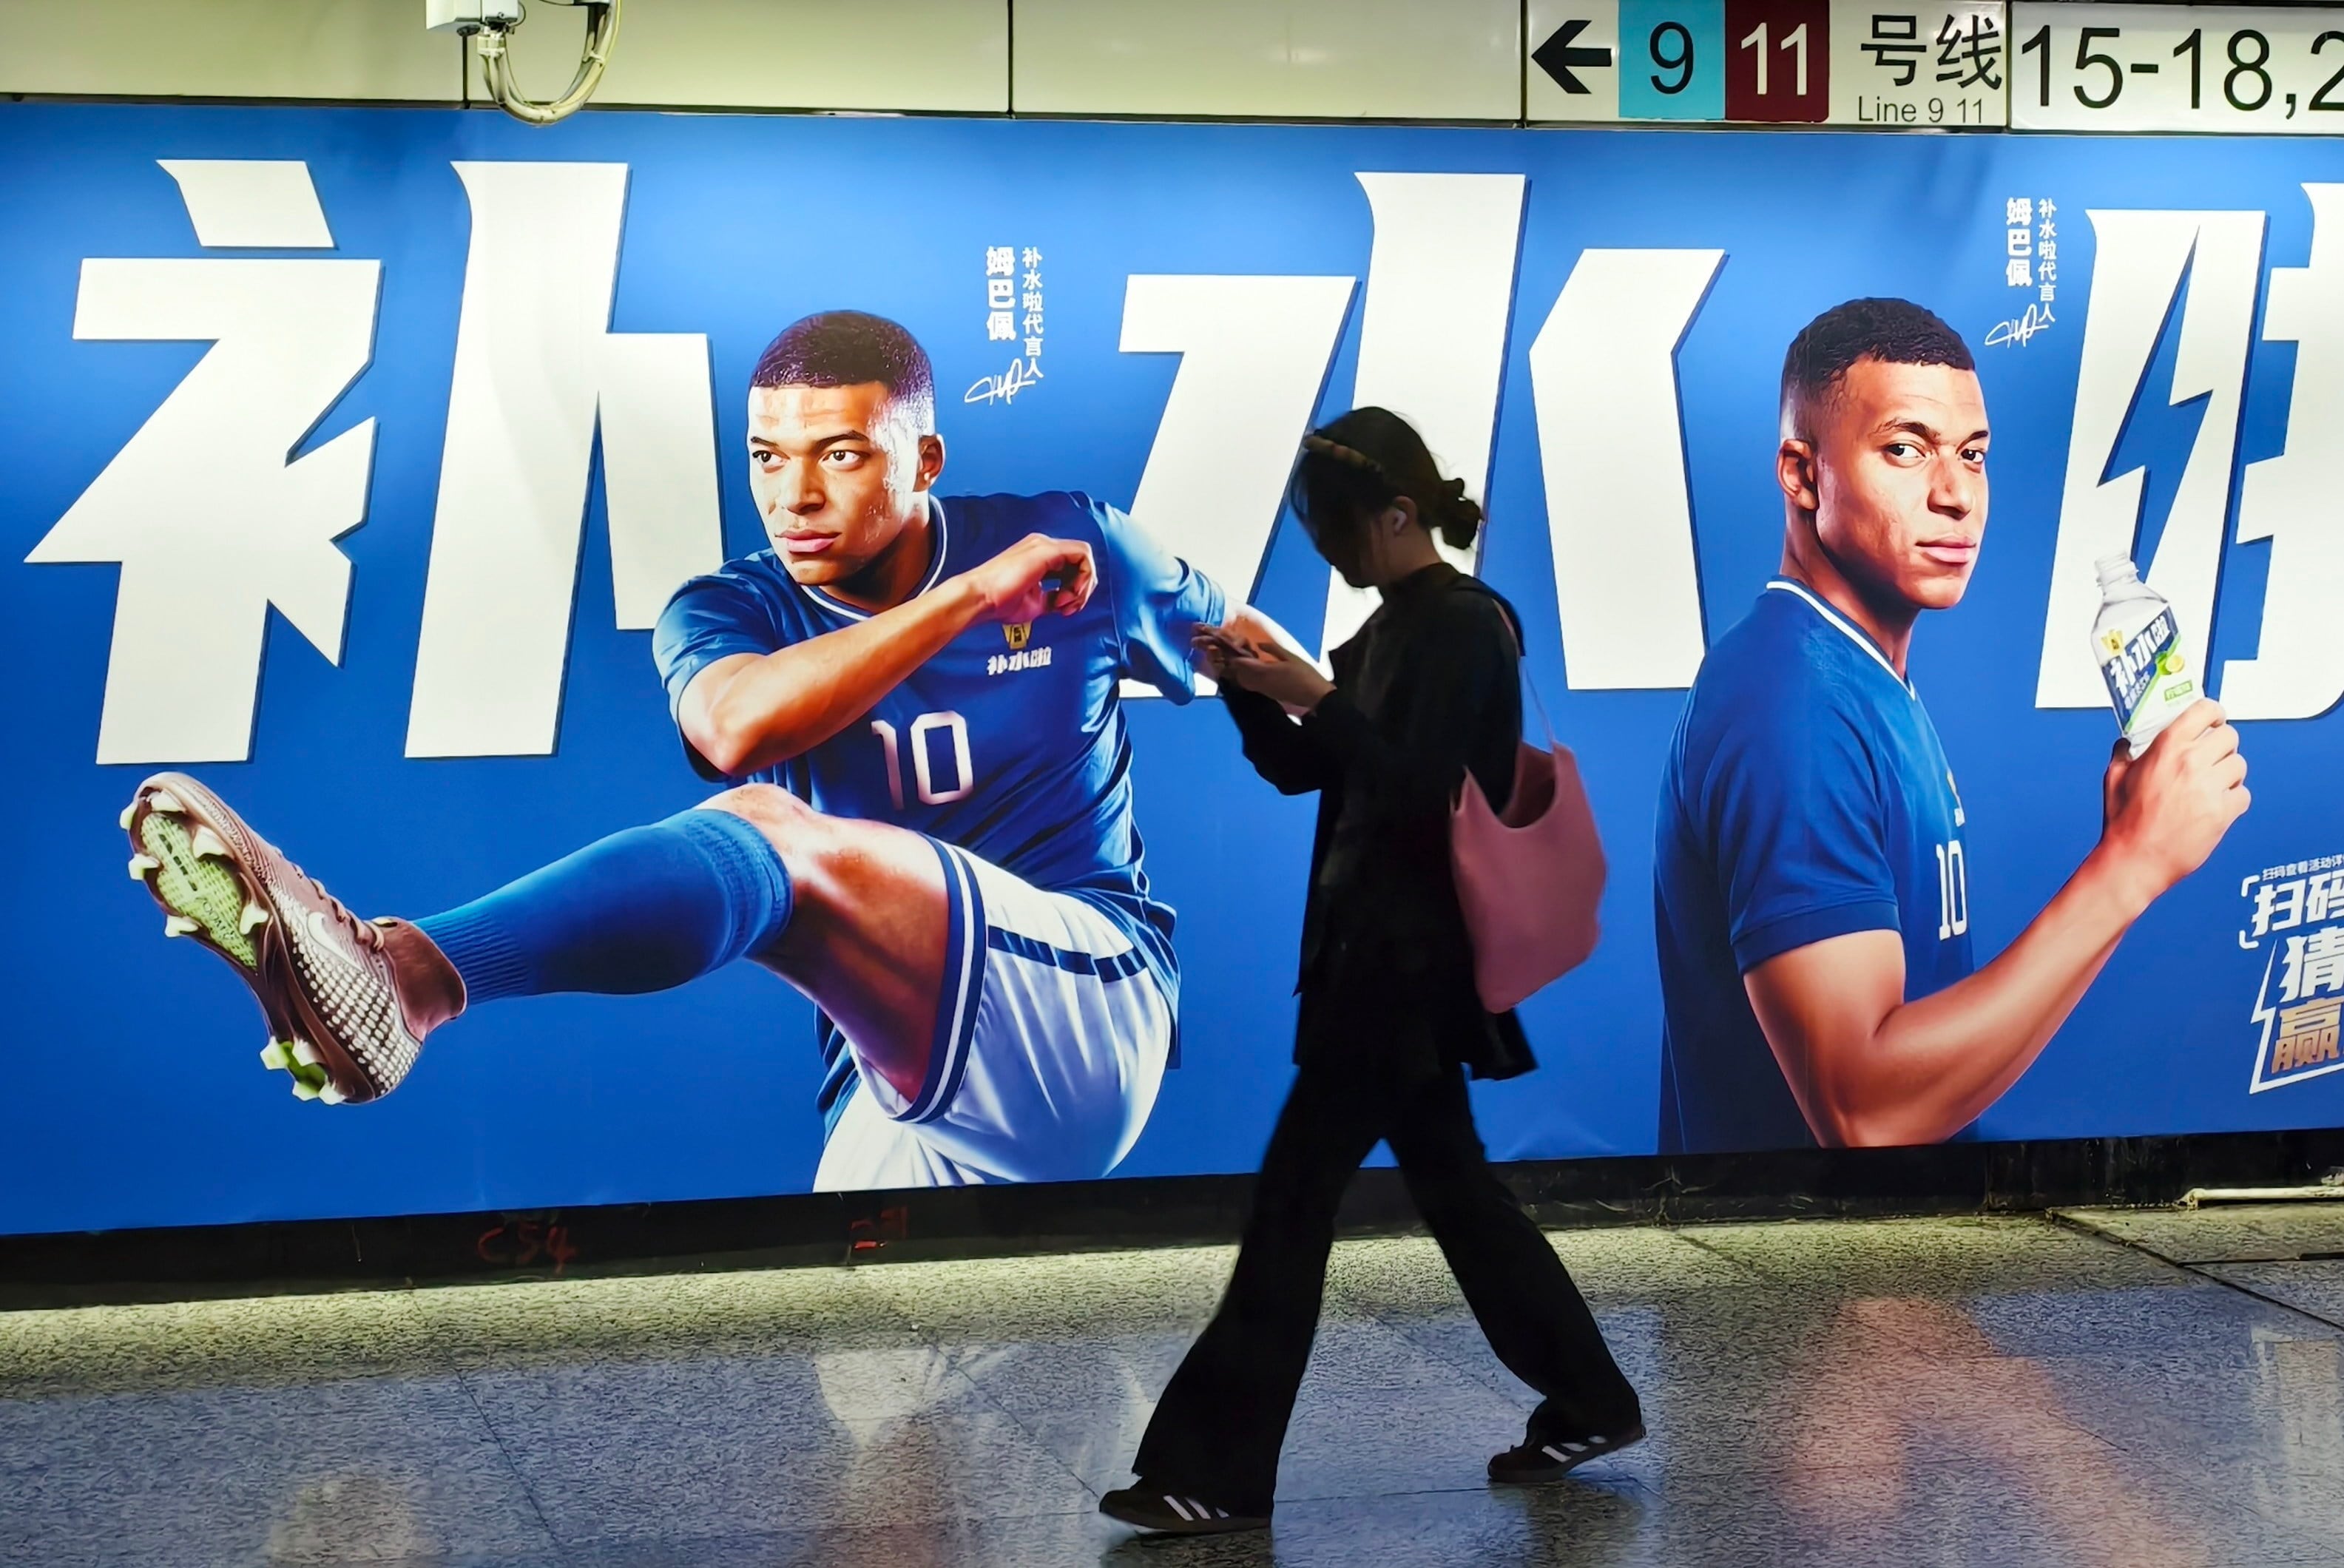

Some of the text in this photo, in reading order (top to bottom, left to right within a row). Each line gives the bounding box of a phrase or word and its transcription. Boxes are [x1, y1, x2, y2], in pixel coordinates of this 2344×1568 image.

[1649, 13, 2002, 95] 9 11 号线
[2022, 24, 2344, 120] 15-18,2
[1858, 95, 1983, 124] Line 9 11
[2005, 197, 2033, 287] 姆巴佩
[2038, 197, 2058, 322] 补水啦代言人
[985, 245, 1017, 341] 姆巴佩
[1021, 246, 1044, 379] 补水啦代言人
[2110, 614, 2171, 698] 补水啦
[871, 710, 973, 811] 10
[1936, 839, 1968, 941] 10
[2263, 853, 2344, 881] 扫码查看活动详
